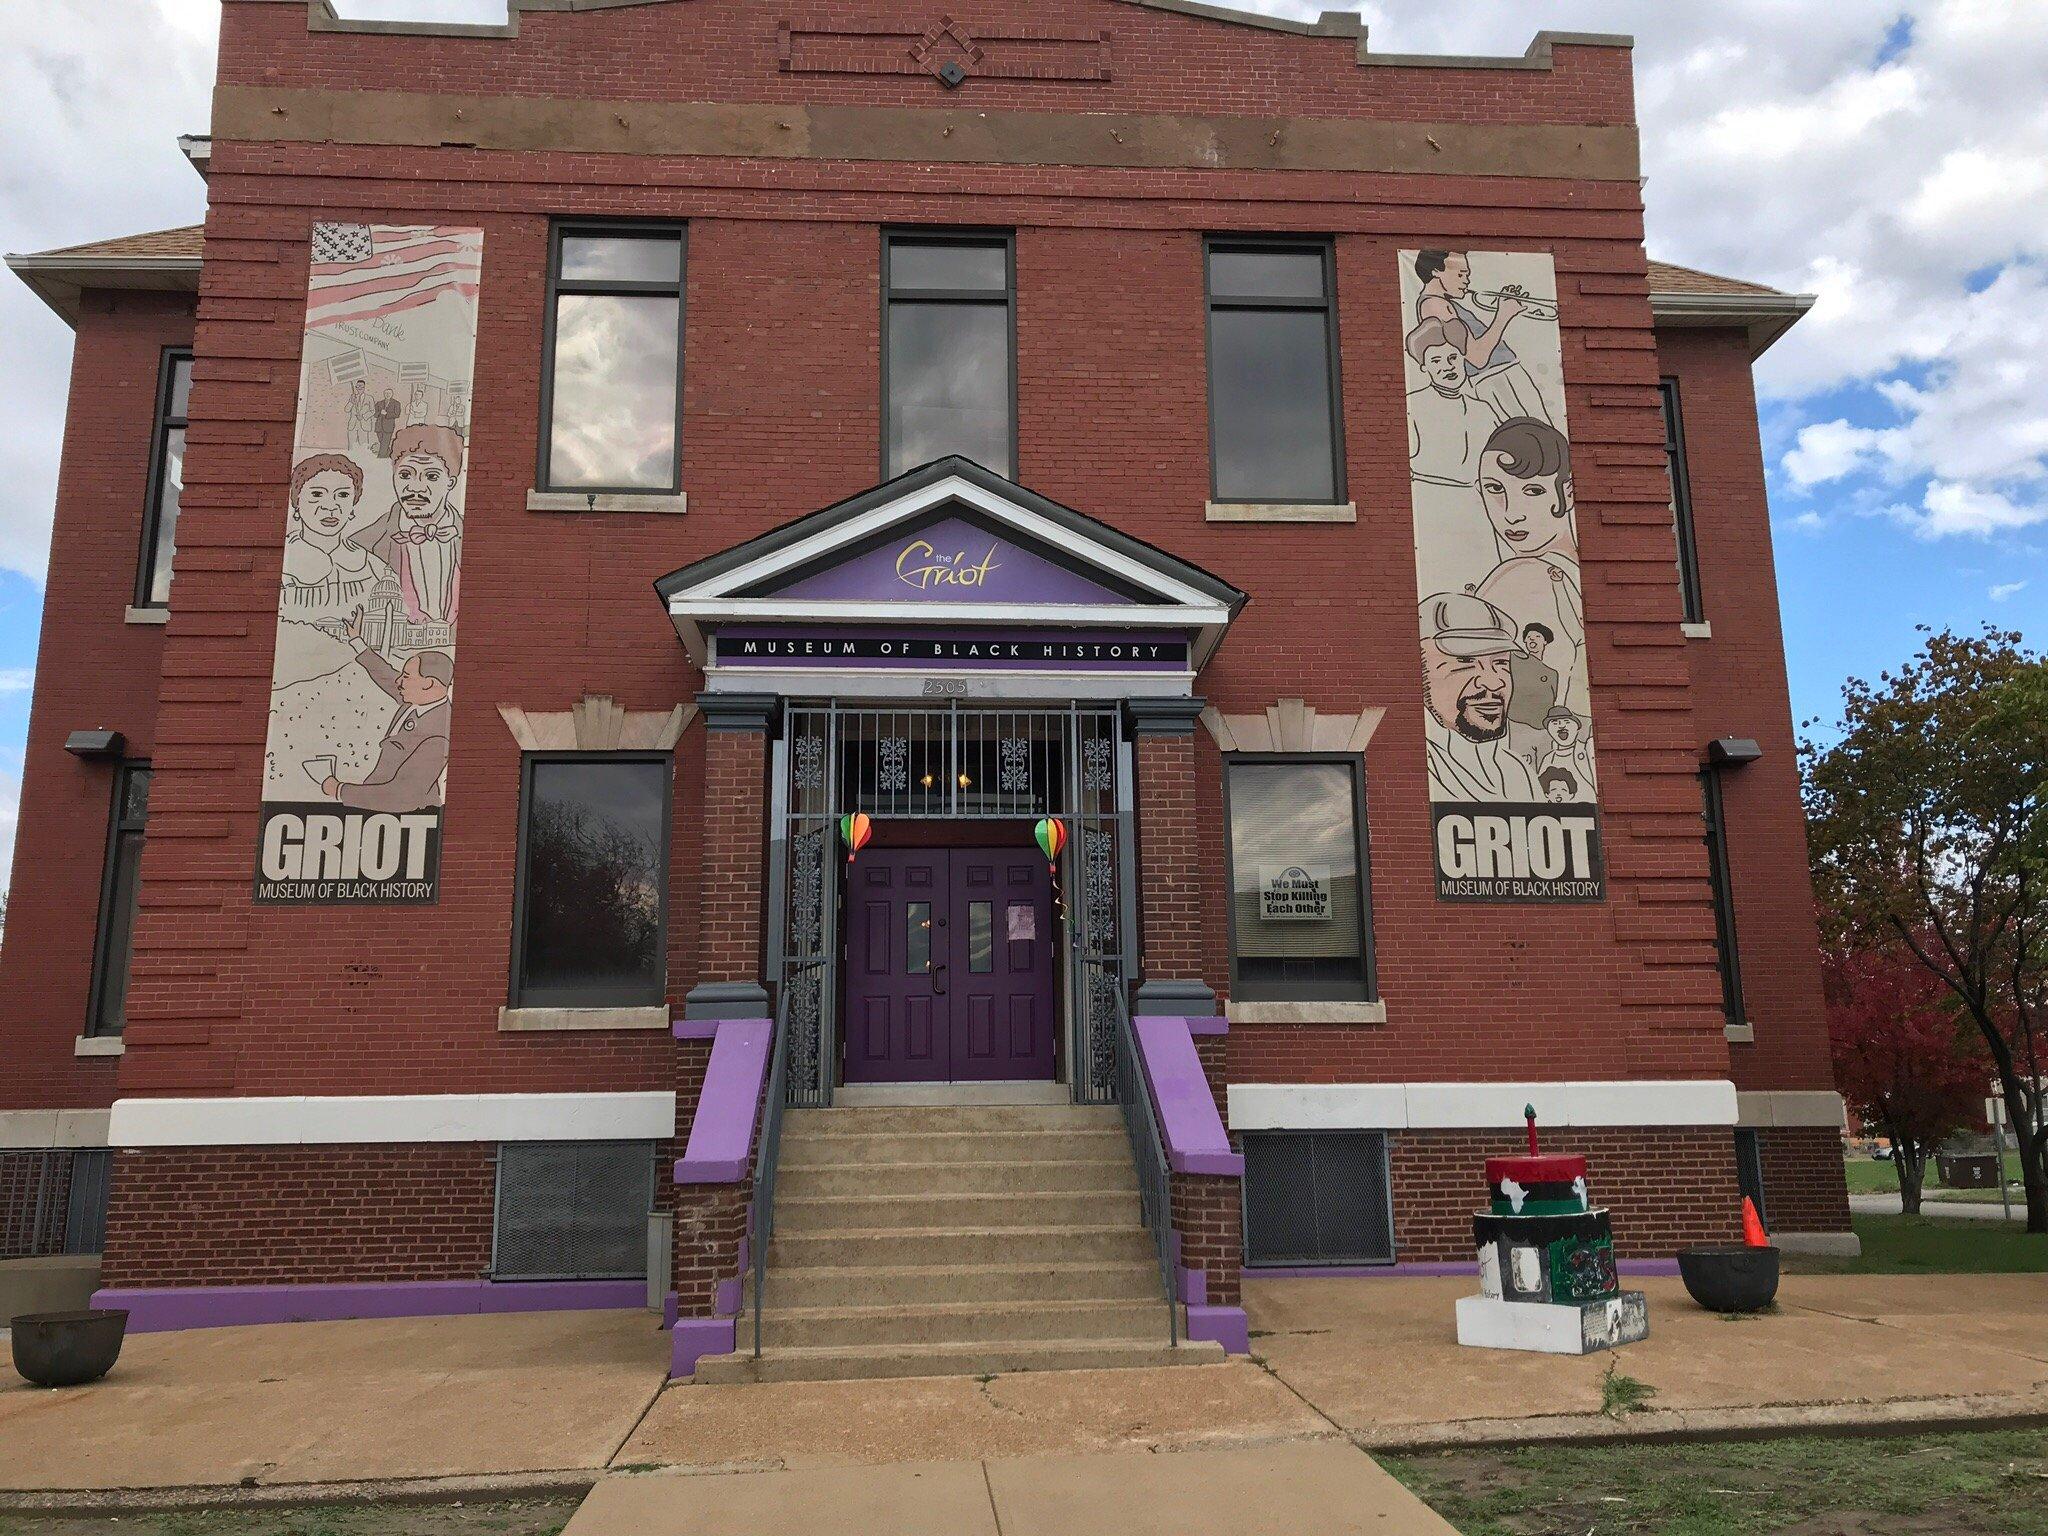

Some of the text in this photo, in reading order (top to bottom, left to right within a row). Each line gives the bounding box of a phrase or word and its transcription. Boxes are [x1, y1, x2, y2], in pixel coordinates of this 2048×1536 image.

[893, 540, 1003, 590] Griot
[935, 554, 952, 563] the
[744, 641, 1159, 658] MUSEUM OF BLACK HISTORY
[923, 680, 967, 695] 2505
[261, 813, 438, 881] GRIOT
[1437, 814, 1596, 880] GRIOT
[258, 882, 434, 899] MUSEUM OF BLACK HISTORY
[1271, 879, 1320, 889] We Must
[1441, 880, 1600, 897] MUSEUM OF BLACK HISTORY
[1264, 891, 1328, 902] Stop Killing
[1266, 903, 1326, 914] Each Other
